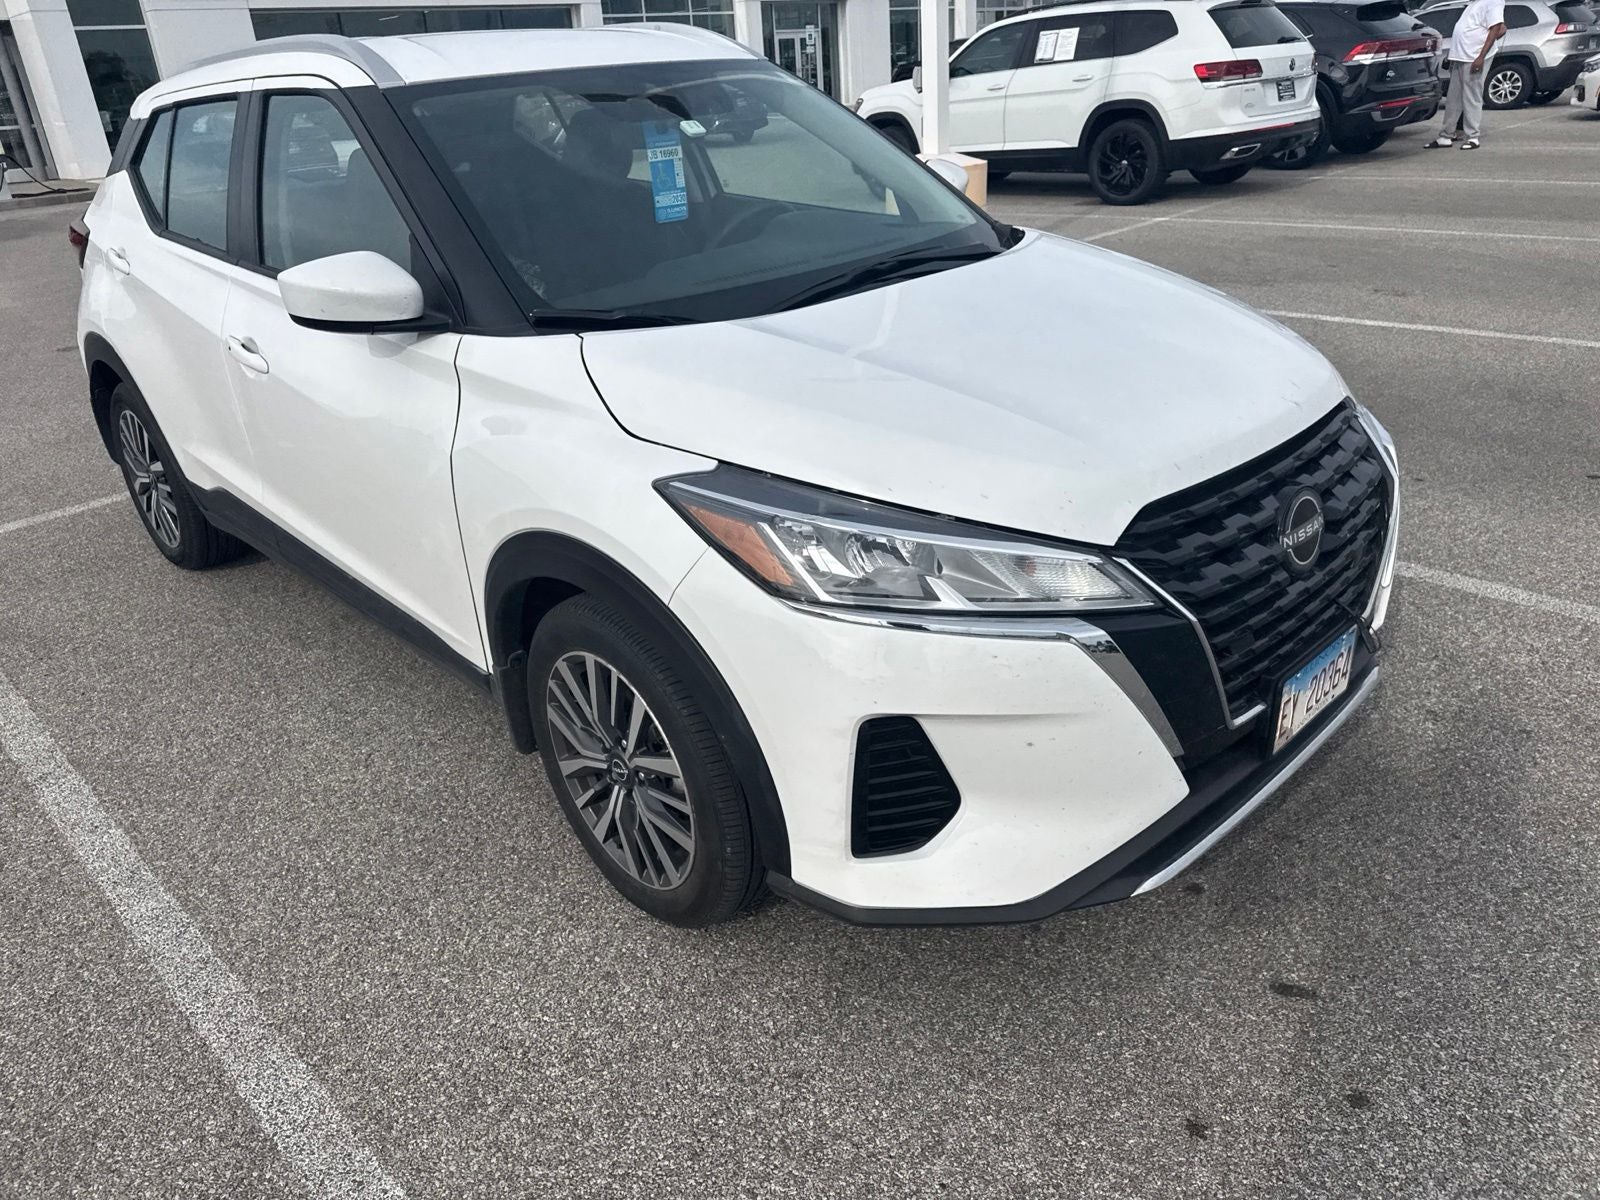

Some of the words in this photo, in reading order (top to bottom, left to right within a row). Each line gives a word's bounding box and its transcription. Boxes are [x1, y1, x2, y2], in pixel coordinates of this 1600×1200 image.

[649, 150, 659, 160] JB
[1283, 513, 1324, 548] NISSAN
[1278, 689, 1301, 740] EY
[1304, 645, 1352, 715] 20364
